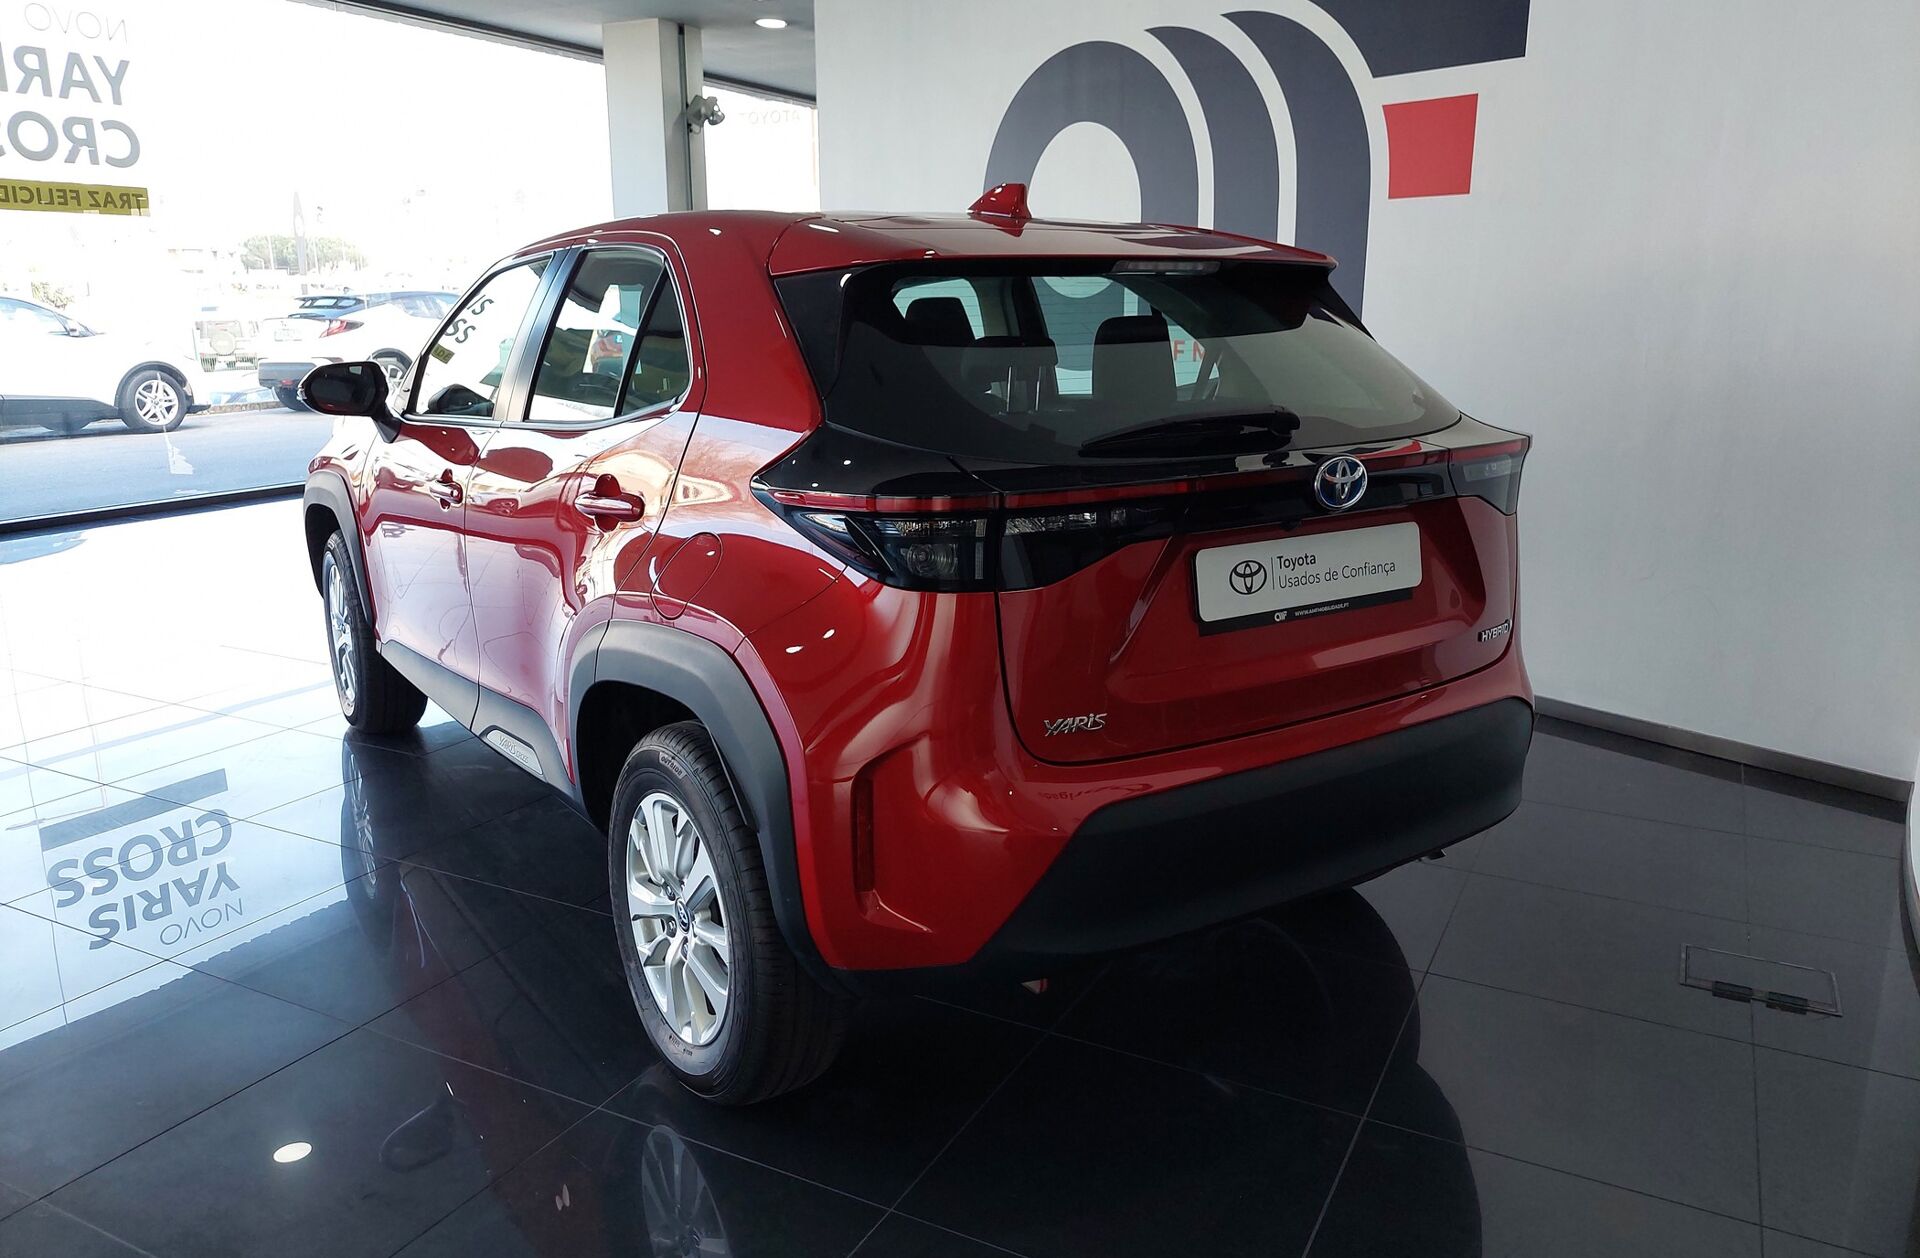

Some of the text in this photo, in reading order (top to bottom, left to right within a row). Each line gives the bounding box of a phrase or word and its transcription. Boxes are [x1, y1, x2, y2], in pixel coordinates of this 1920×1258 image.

[1277, 553, 1317, 572] Toyota
[1278, 562, 1396, 589] Usados de Confiança
[1481, 622, 1509, 642] HYBRID
[47, 808, 232, 908] CROSS
[88, 861, 241, 951] YARIS
[159, 898, 243, 945] NOVO
